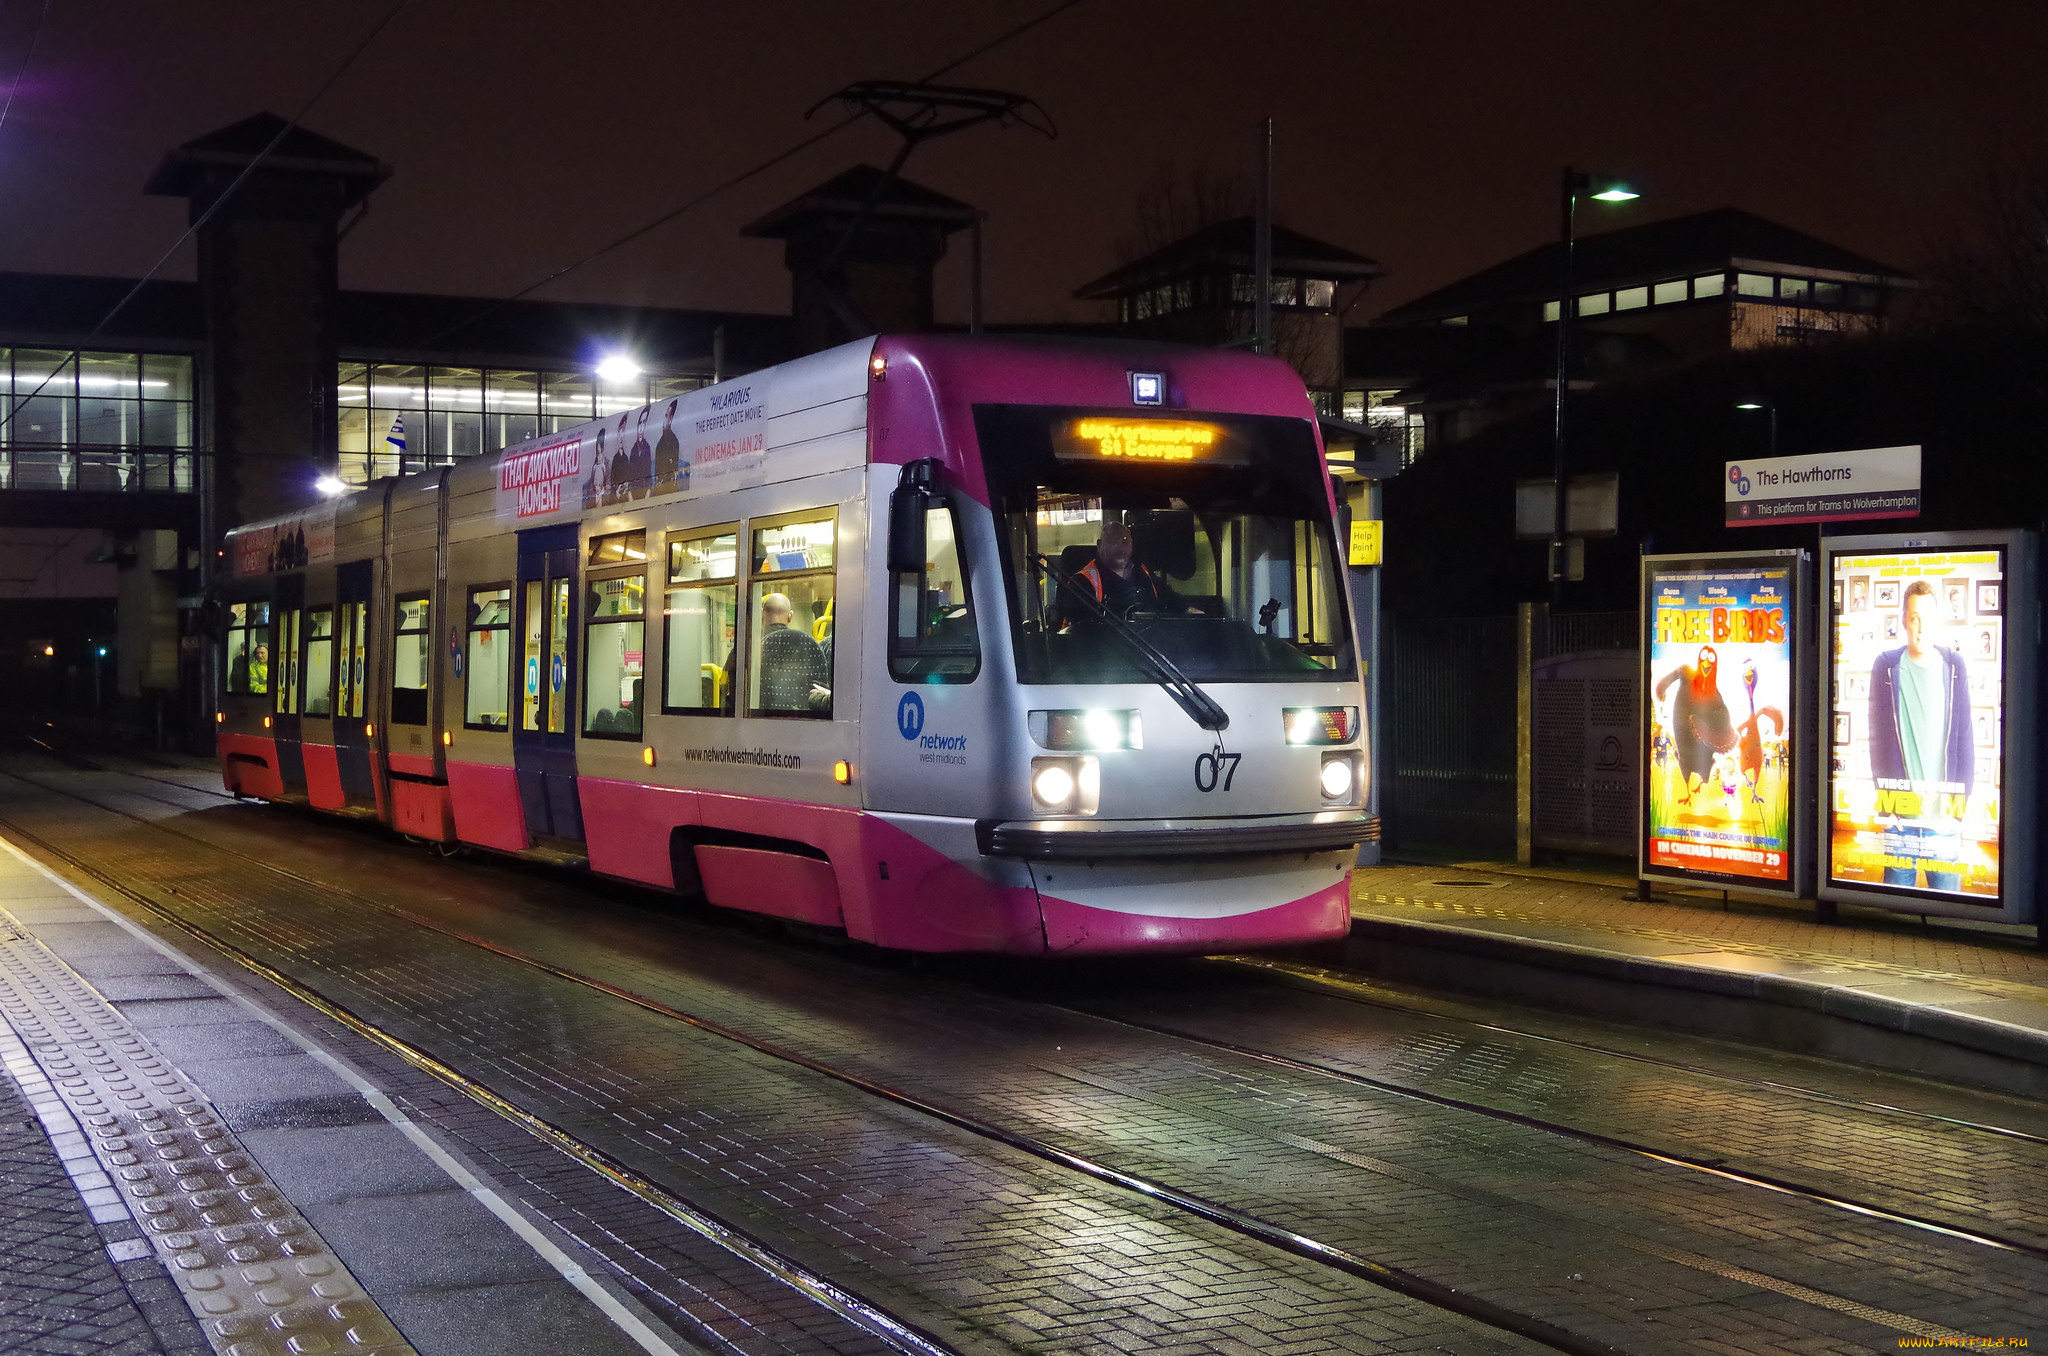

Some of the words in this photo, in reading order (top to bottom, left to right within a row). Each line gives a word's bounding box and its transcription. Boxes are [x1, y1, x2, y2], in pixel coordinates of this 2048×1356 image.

[695, 421, 705, 433] THE
[706, 414, 730, 431] PERFECT
[730, 411, 744, 425] DATE
[1080, 423, 1212, 444] Wolverhampton
[695, 448, 703, 464] IN
[704, 440, 736, 461] CINEMAS
[737, 436, 752, 455] JAN
[754, 433, 763, 451] 29
[1100, 439, 1123, 455] St
[1125, 439, 1193, 460] Georges
[504, 455, 529, 489] THAT
[527, 442, 580, 483] AWKWARD
[1757, 471, 1779, 486] The
[1782, 465, 1851, 483] Hawthorns
[518, 479, 561, 515] MOMENT
[1757, 504, 1773, 515] This
[1773, 502, 1805, 516] platform
[1806, 501, 1817, 512] for
[1818, 500, 1842, 511] Trams
[1843, 499, 1851, 510] to
[1852, 496, 1917, 510] Wolverhampton
[1353, 531, 1373, 541] Help
[1352, 543, 1373, 551] Point
[1658, 595, 1685, 605] Wilson
[1698, 595, 1738, 605] Harrelson
[1751, 594, 1783, 604] Poehler
[1656, 607, 1711, 643] FREE
[1712, 606, 1786, 644] BIRDS
[920, 733, 967, 750] network
[684, 746, 801, 770] www.networkwestmidlands.com
[920, 752, 935, 763] west
[935, 752, 967, 765] midlands
[1194, 752, 1242, 793] 07
[1877, 778, 1911, 791] VINCE
[1946, 793, 1998, 820] MN
[1703, 830, 1718, 840] MAIN
[1657, 840, 1670, 853] IN
[1670, 842, 1713, 858] CINEMAS
[1713, 846, 1764, 864] NOVEMBER
[1765, 854, 1781, 866] 29
[1862, 852, 1913, 870] CINEMAS
